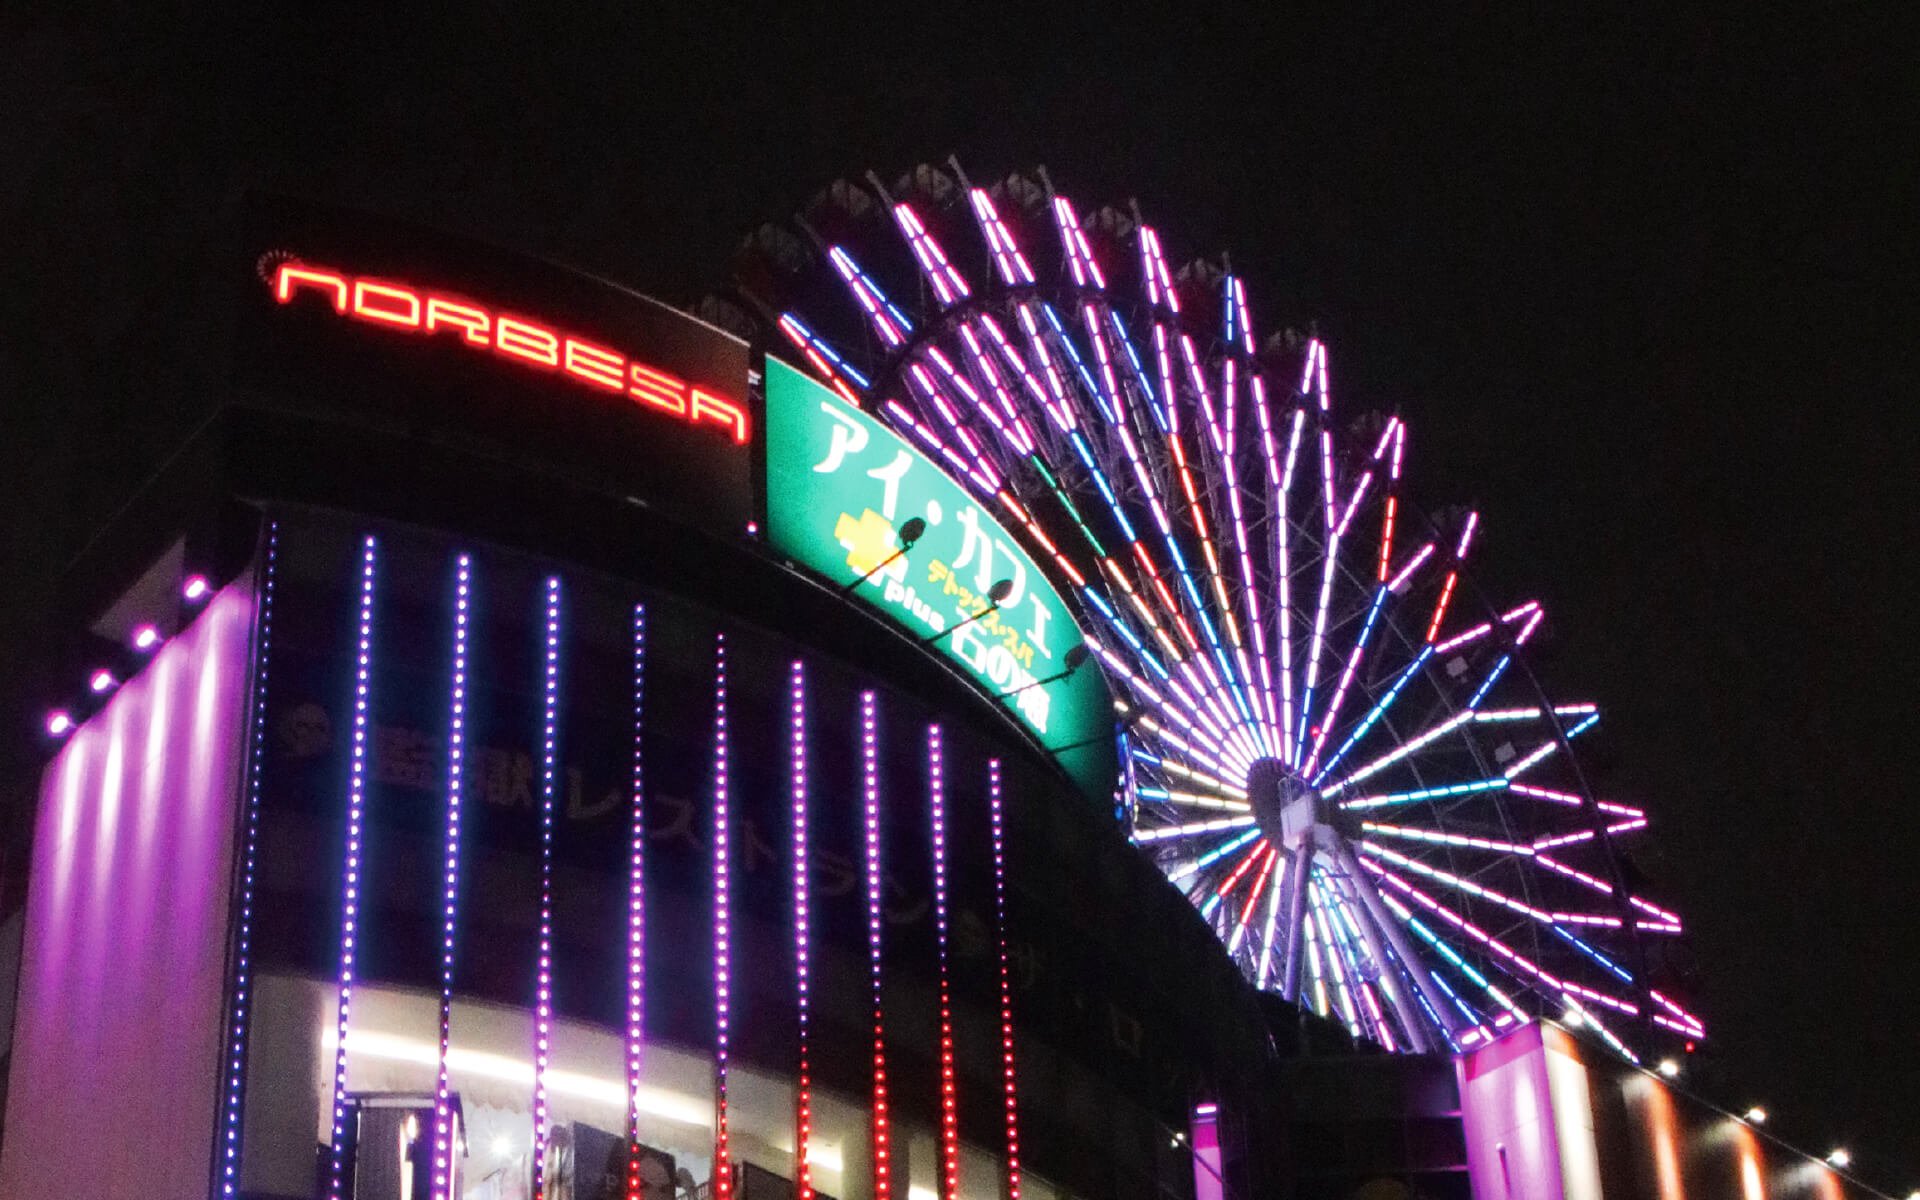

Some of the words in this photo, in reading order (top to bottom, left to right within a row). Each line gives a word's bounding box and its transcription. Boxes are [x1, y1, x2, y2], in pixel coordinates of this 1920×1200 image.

[277, 262, 749, 443] NORBESA
[813, 401, 1052, 660] アイ・カフェ
[884, 578, 945, 633] plus
